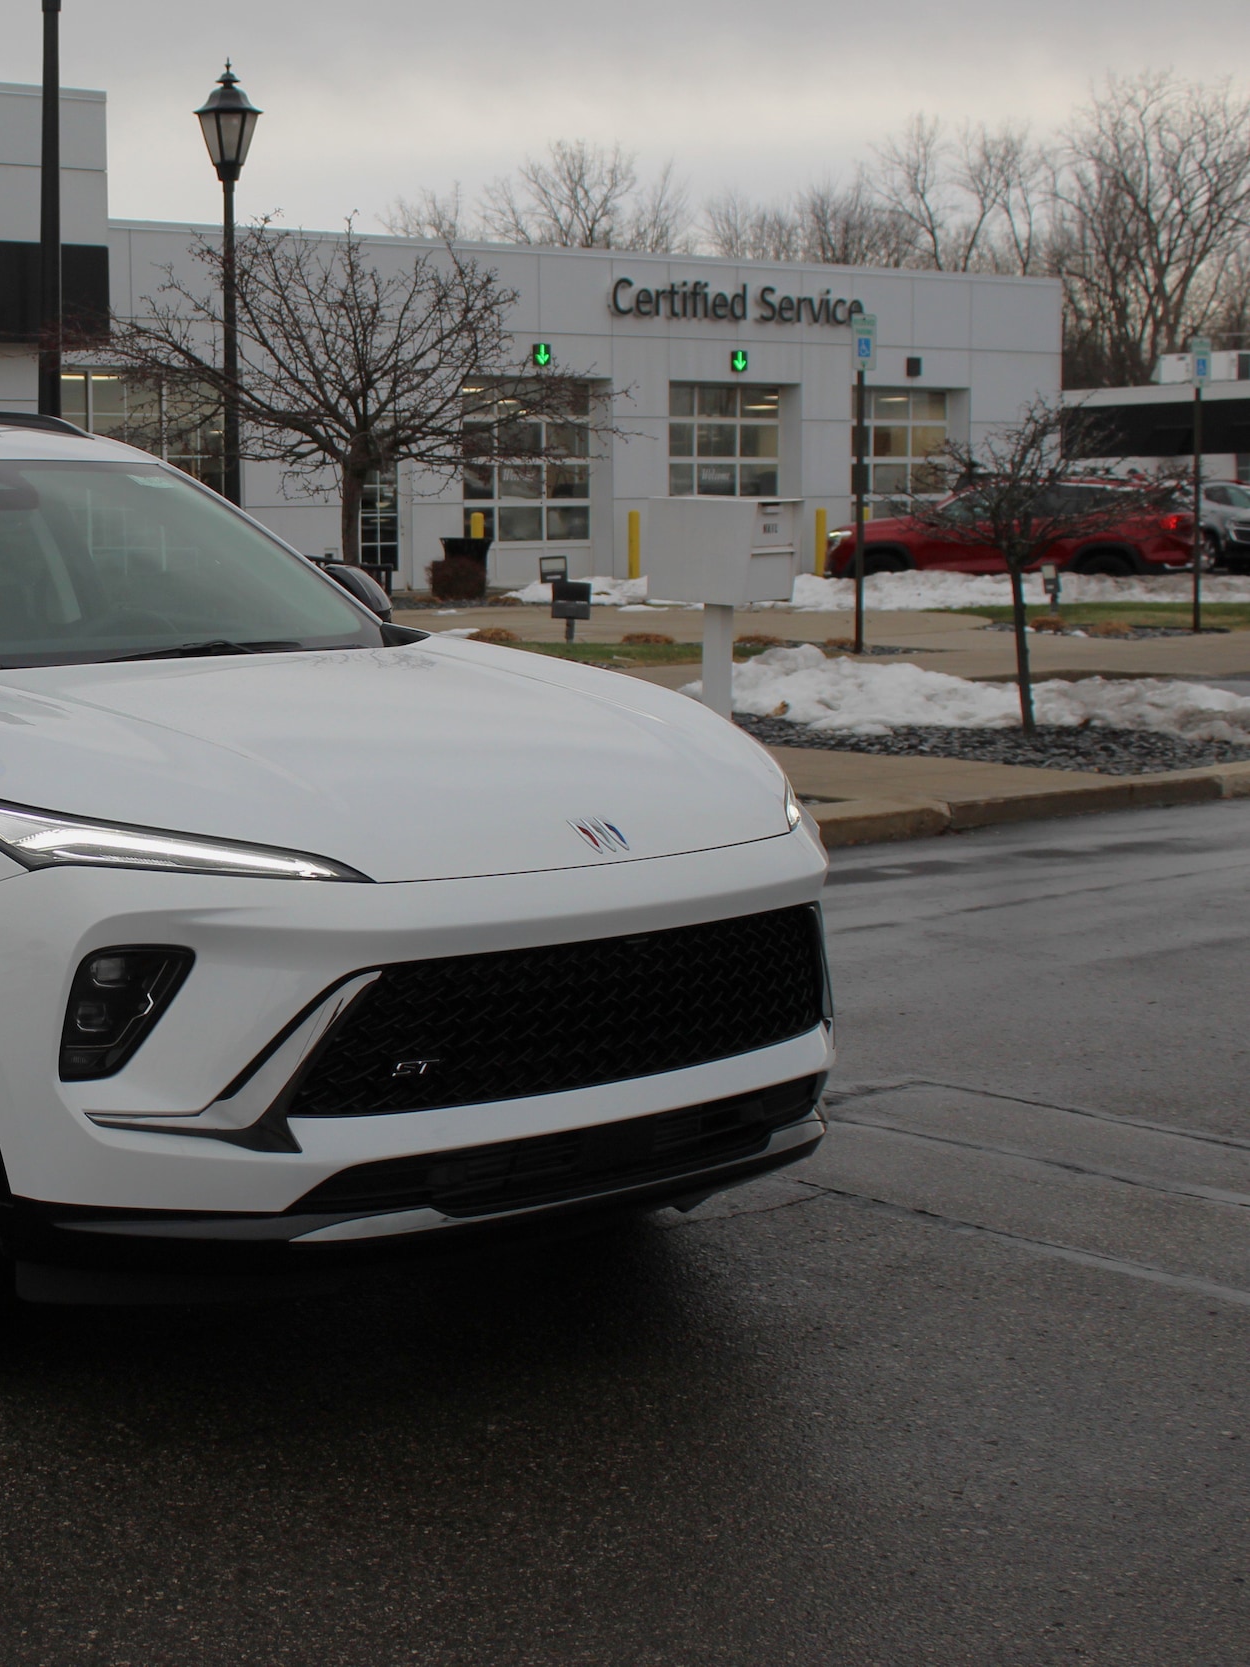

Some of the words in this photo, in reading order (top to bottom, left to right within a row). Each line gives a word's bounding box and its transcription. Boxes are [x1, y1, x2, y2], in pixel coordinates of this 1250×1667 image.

[611, 277, 747, 321] Certified
[759, 286, 865, 325] Service
[391, 1059, 440, 1077] ST
